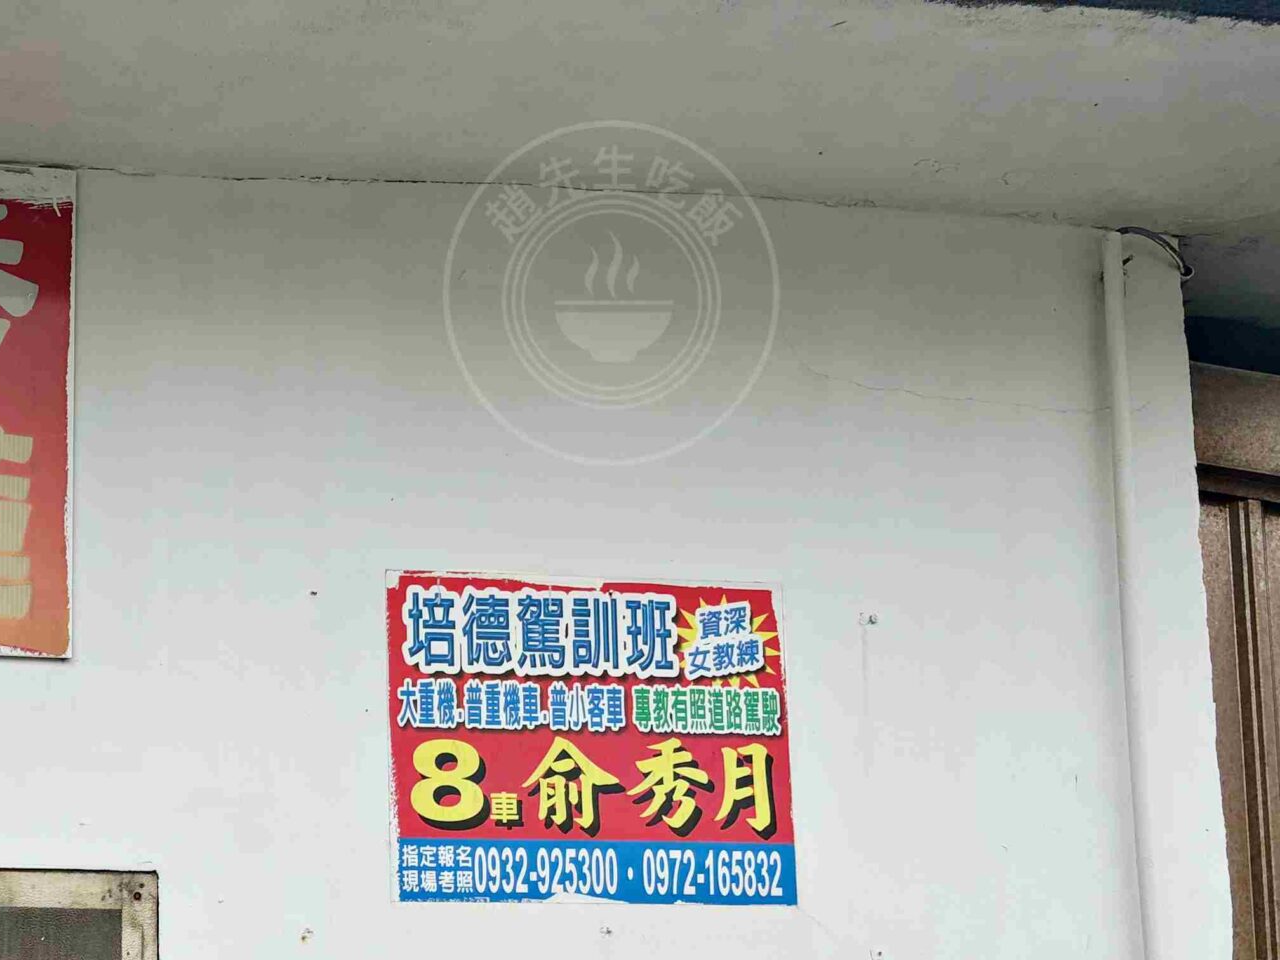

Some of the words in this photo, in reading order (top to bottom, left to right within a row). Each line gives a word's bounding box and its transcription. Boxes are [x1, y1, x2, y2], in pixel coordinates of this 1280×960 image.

[407, 590, 675, 672] 培德駕訓班
[699, 606, 748, 639] 資深
[688, 638, 764, 675] 女教練
[402, 845, 473, 868] 指定報名
[474, 847, 618, 895] 0932-925300
[643, 849, 783, 896] 0972-165832
[402, 869, 473, 893] 現場考照
